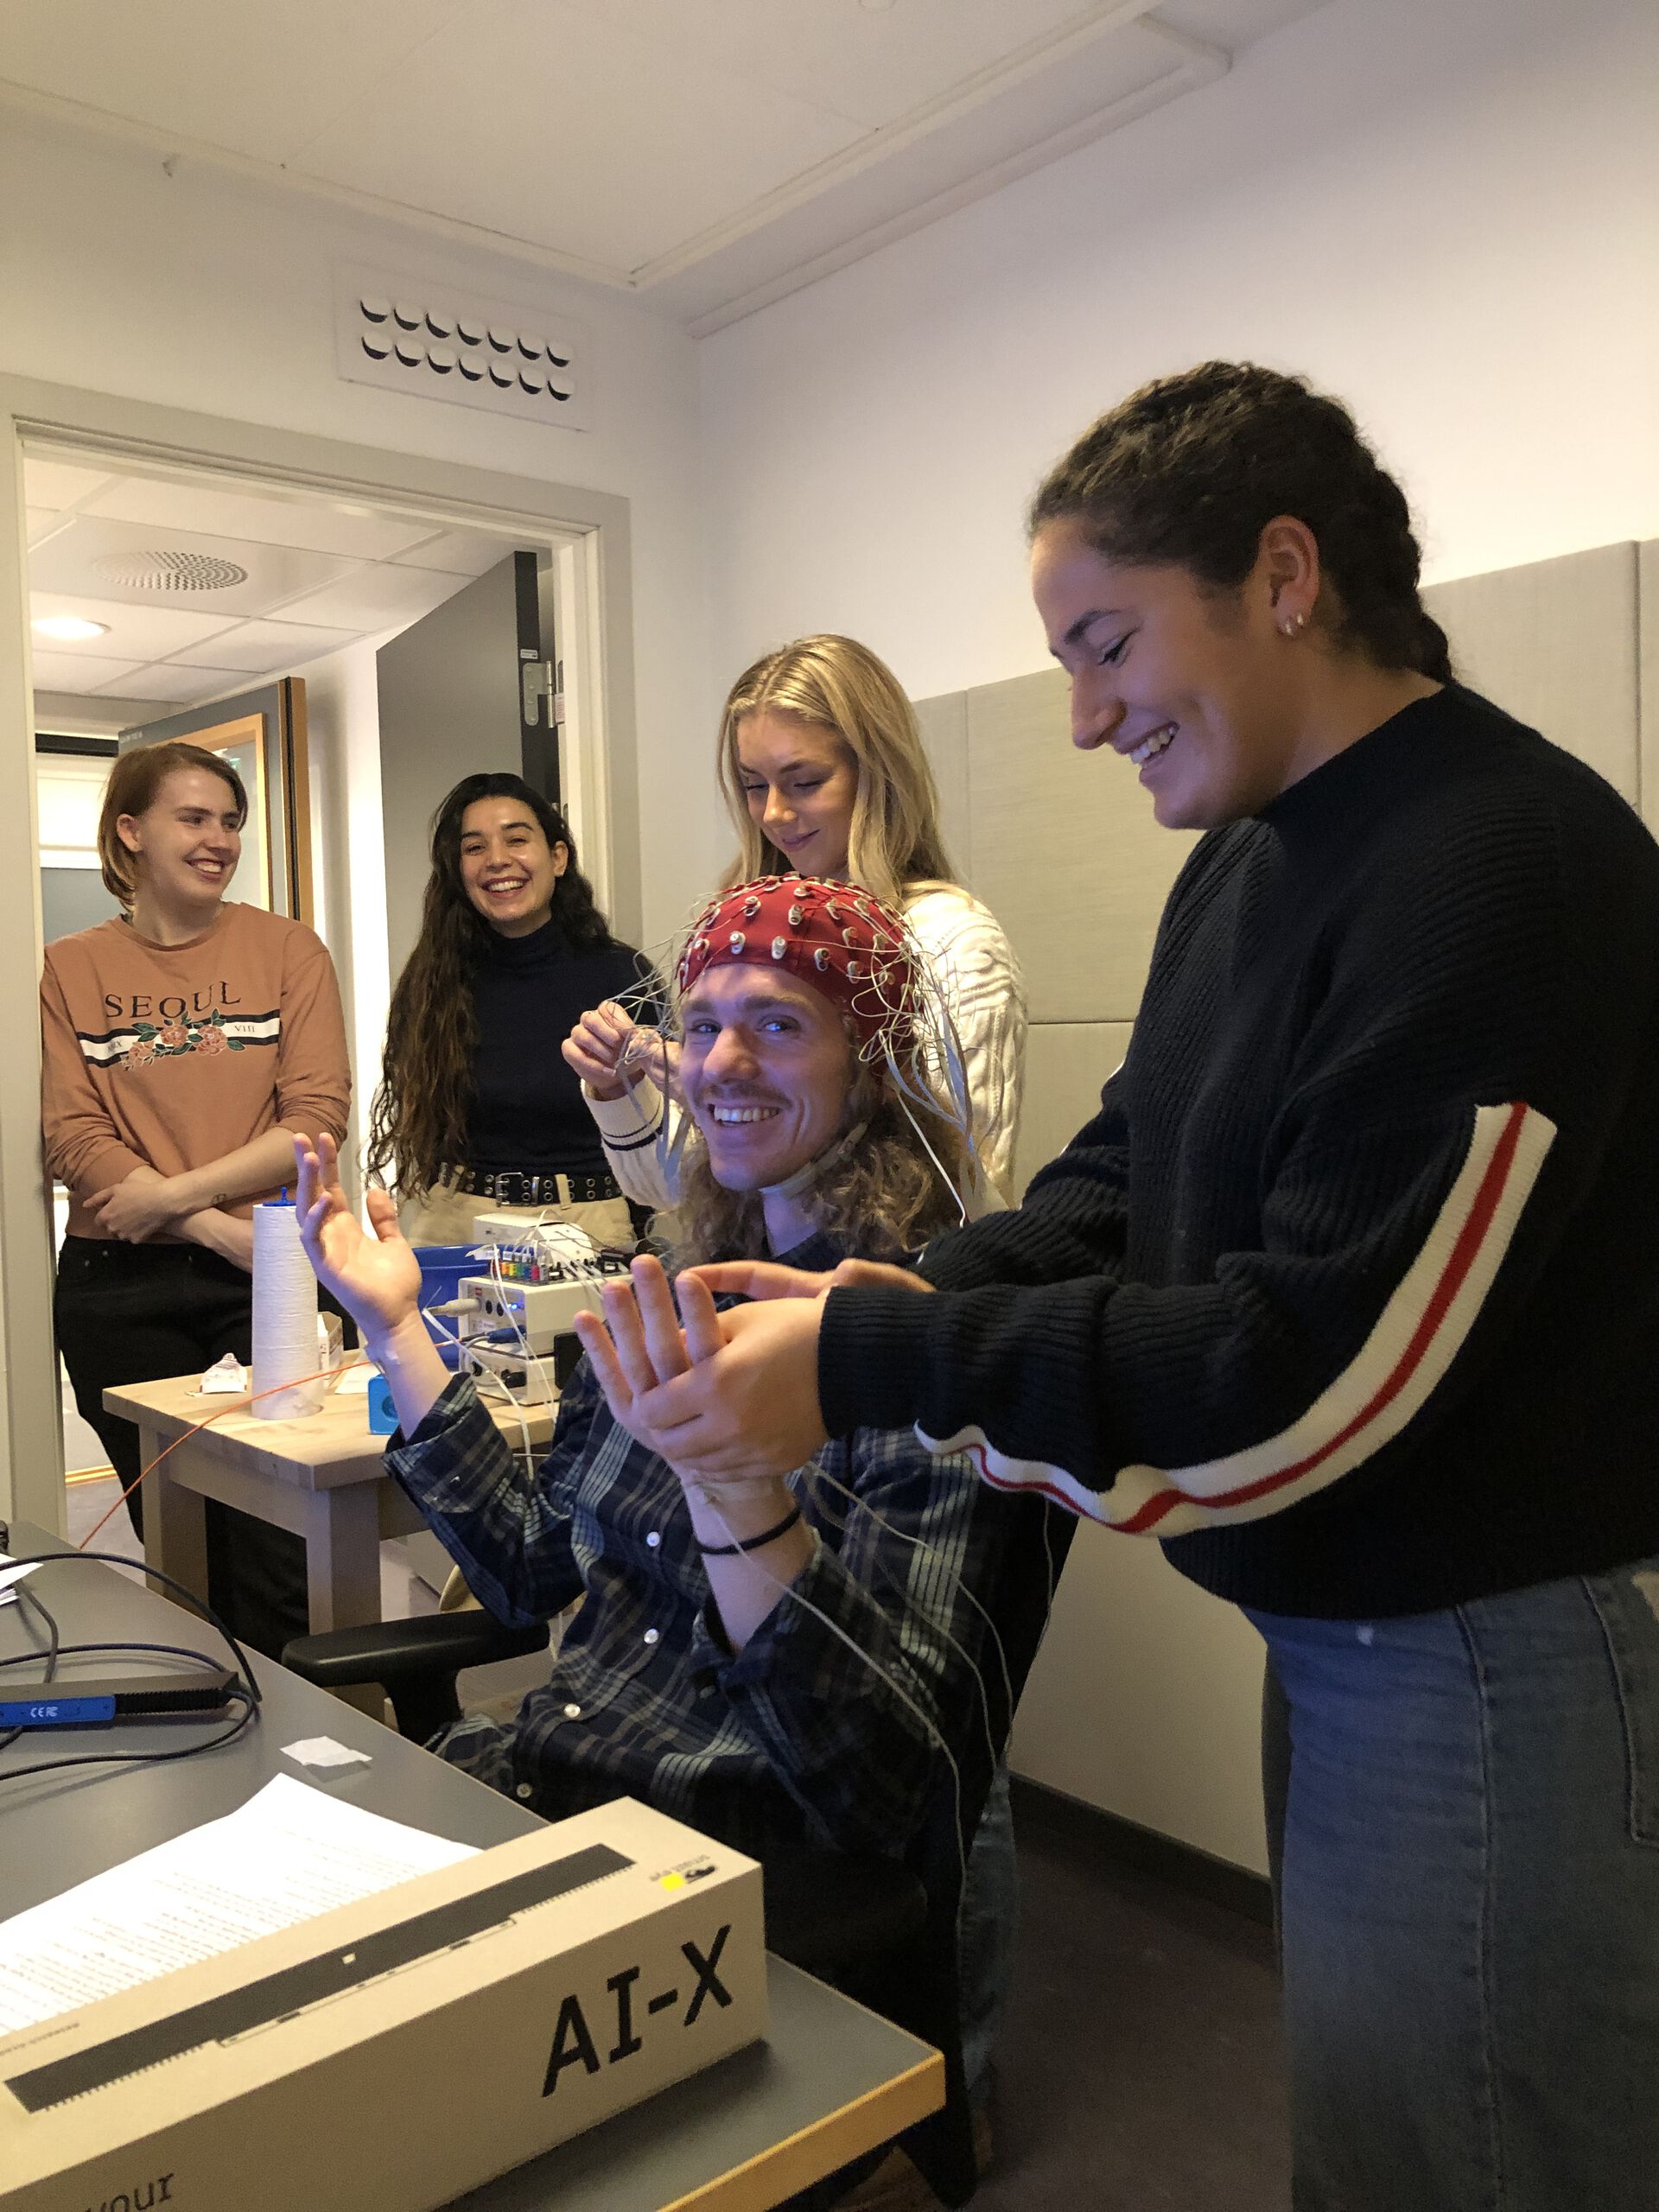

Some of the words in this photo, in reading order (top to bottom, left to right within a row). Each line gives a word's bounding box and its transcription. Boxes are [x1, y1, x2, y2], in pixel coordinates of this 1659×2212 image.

[105, 981, 241, 1018] SEOUL
[542, 1924, 733, 2097] AI-X
[85, 2173, 175, 2212] our
